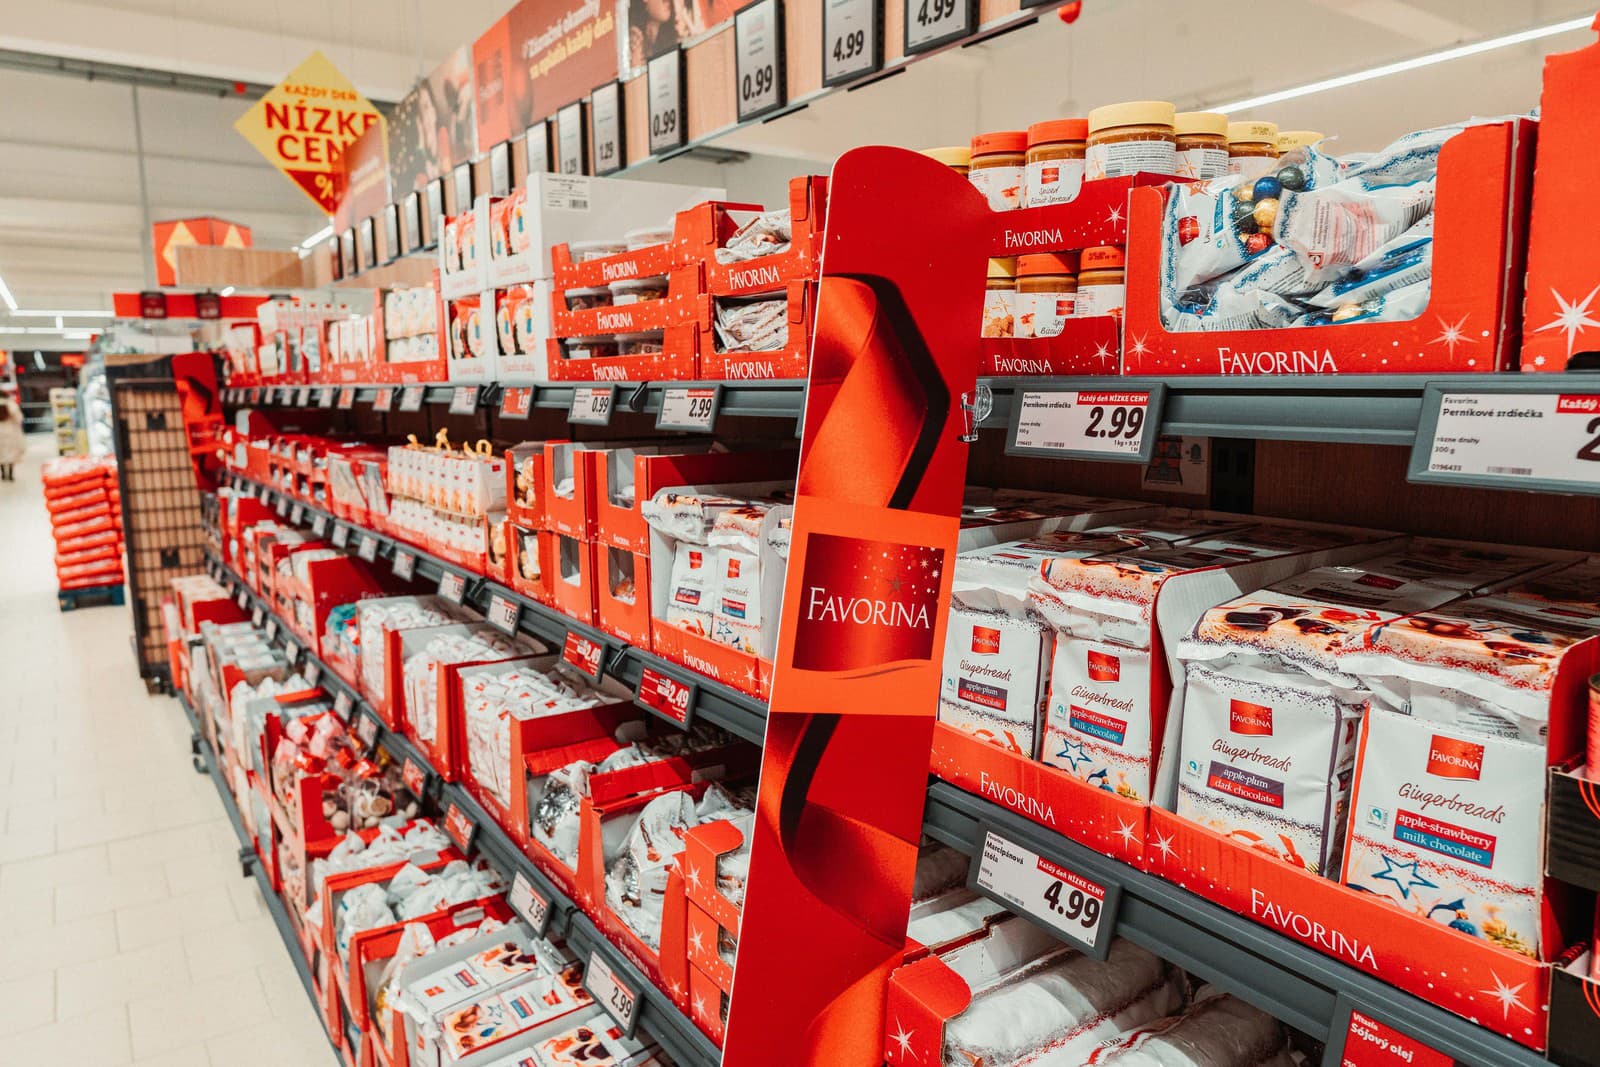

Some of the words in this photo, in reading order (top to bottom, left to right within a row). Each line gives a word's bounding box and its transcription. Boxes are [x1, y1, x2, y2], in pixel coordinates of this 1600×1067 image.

[833, 30, 864, 62] 4.99
[742, 64, 773, 101] 0.99
[653, 109, 676, 137] 0.99
[276, 134, 351, 164] CEN
[1004, 228, 1063, 248] FAVORINA
[601, 259, 638, 281] FAVORINA
[728, 264, 780, 290] FAVORINA
[597, 311, 633, 330] FAVORINA
[591, 362, 628, 381] FAVORINA
[724, 358, 776, 380] FAVORINA
[993, 354, 1053, 373] FAVORINA
[1217, 347, 1339, 374] FAVORINA
[591, 397, 609, 414] 0.99
[688, 398, 713, 418] 2.99
[1078, 395, 1097, 404] Každý
[1109, 393, 1129, 403] NÍZKE
[1130, 394, 1148, 403] CENY
[1559, 398, 1597, 412] Každý
[1085, 406, 1144, 439] 2.99
[807, 586, 930, 629] FAVORINA
[972, 635, 999, 648] FAVORINA
[682, 648, 721, 679] FAVORINA
[959, 658, 1012, 682] Gingerbreads
[1088, 661, 1118, 675] FAVORINA
[668, 684, 689, 709] 2.49
[1071, 685, 1134, 713] Gingerbreads
[1071, 709, 1125, 731] apple-strawberry
[1231, 712, 1271, 729] FAVORINA
[1087, 725, 1119, 741] chocolate
[1212, 738, 1292, 773] Gingerbreads
[1431, 749, 1480, 771] FAVORINA
[1214, 779, 1233, 793] dark
[1233, 785, 1275, 803] chocolate
[1223, 768, 1268, 789] apple-plum
[979, 771, 1056, 825] FAVORINA
[1398, 782, 1506, 824] Gingerbreads
[1398, 813, 1492, 850] apple-strawberry
[986, 840, 1024, 865] Marcipánová
[1402, 831, 1428, 847] milk
[1429, 839, 1482, 862] chocolate
[1038, 859, 1056, 874] Každý
[1067, 873, 1087, 889] NÍZKE
[1087, 882, 1105, 897] CENY
[528, 898, 544, 924] 2.99
[1044, 880, 1100, 928] 4.99
[1251, 887, 1379, 970] FAVORINA
[611, 986, 632, 1019] 2.99
[1352, 1011, 1378, 1031] Vitasia
[1350, 1023, 1389, 1050] Sójový
[1389, 1044, 1414, 1063] olej
